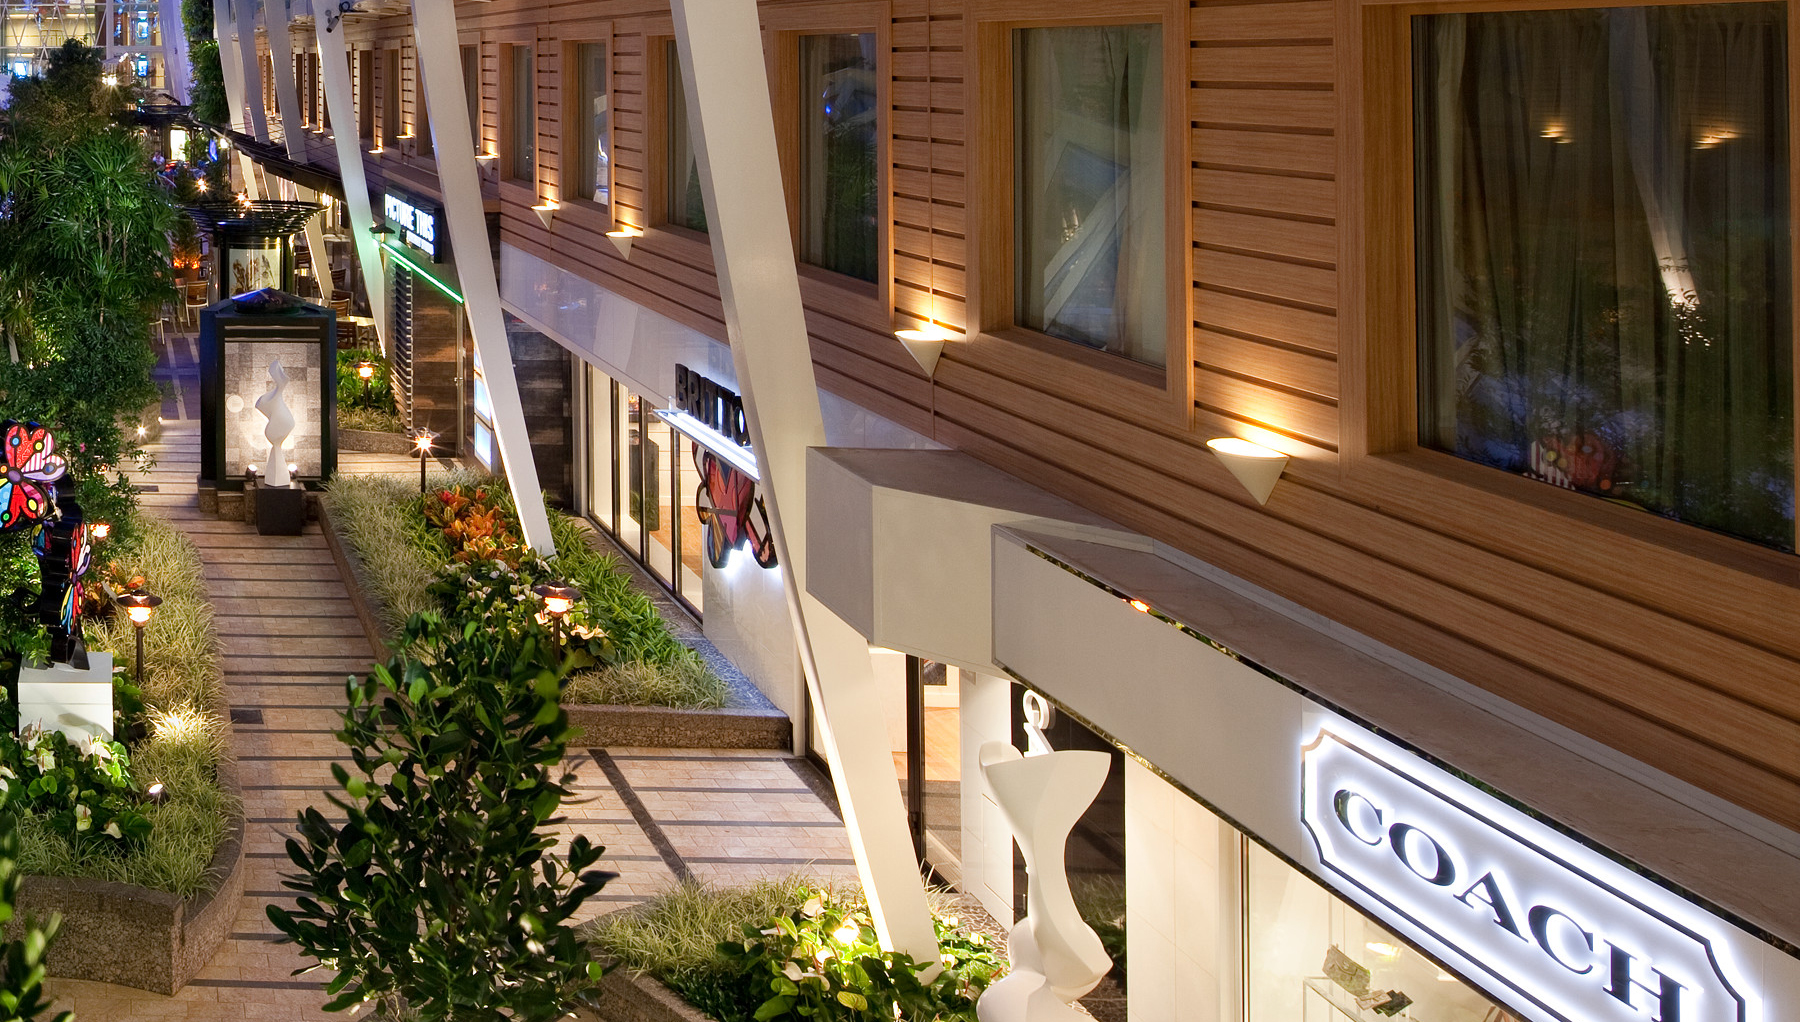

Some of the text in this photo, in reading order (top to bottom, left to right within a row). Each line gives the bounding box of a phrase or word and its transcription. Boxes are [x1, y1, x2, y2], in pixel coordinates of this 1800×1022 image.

[385, 193, 434, 242] PICTURE THIS
[675, 363, 751, 447] BRITTO
